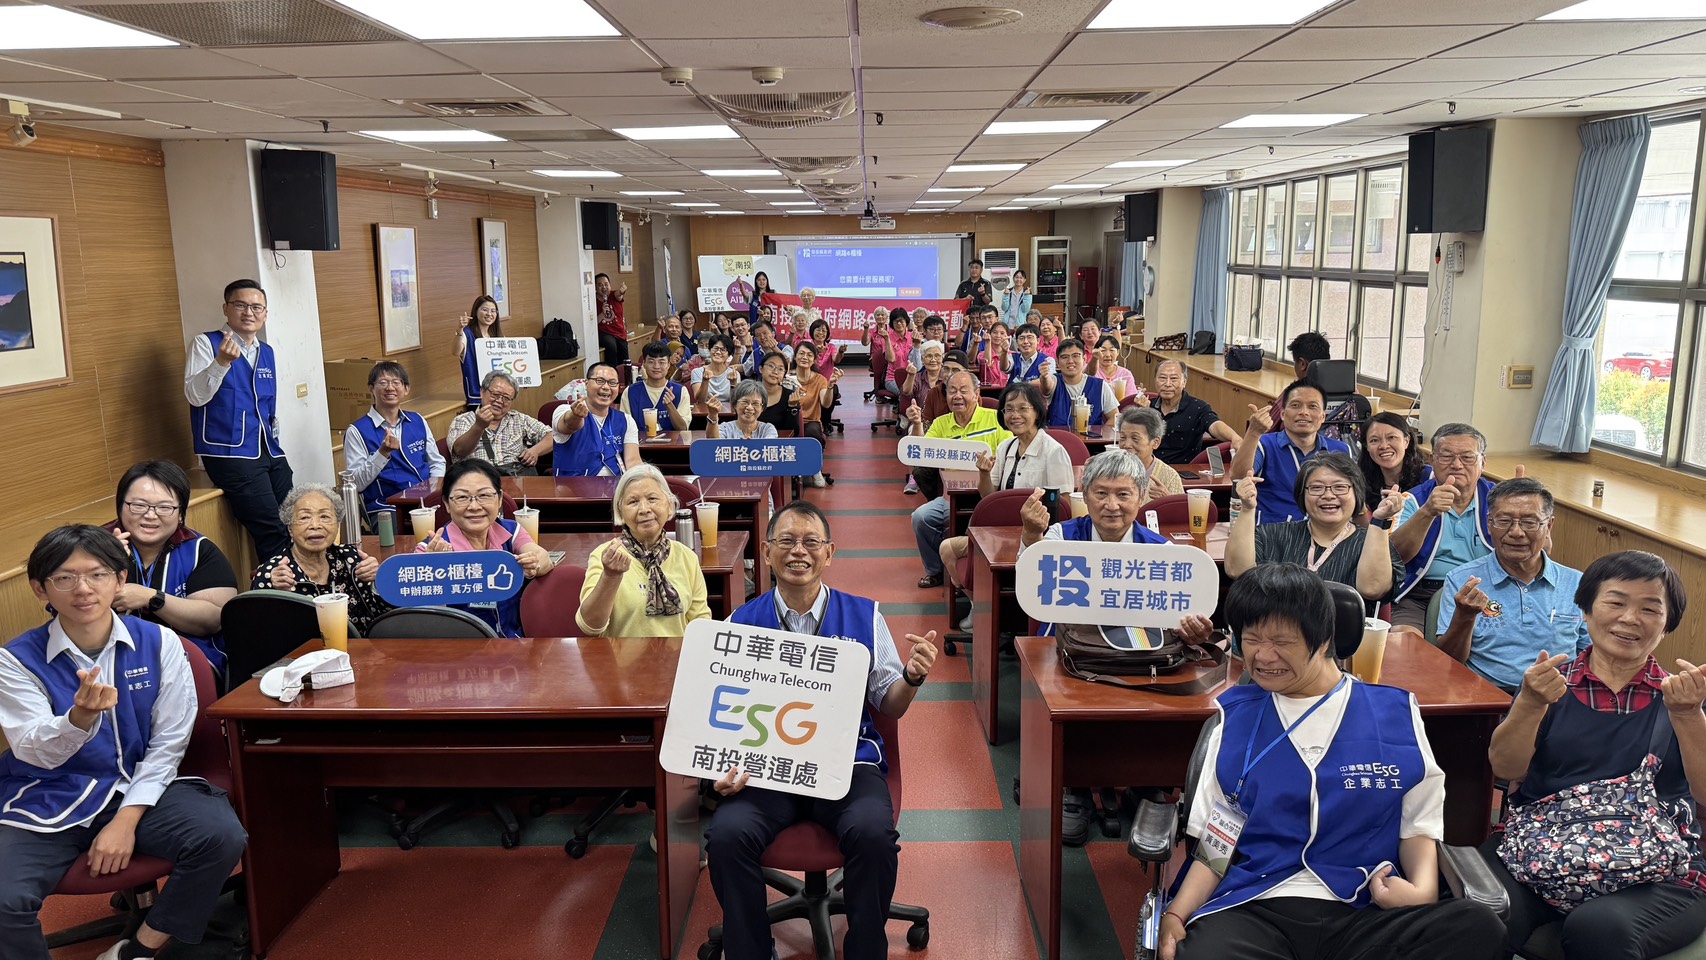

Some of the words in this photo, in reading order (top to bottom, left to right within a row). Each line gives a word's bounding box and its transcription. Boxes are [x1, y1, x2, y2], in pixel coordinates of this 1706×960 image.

[485, 340, 527, 349] 中華電信
[491, 358, 527, 375] ESG
[715, 445, 797, 463] 網路e櫃檯
[397, 563, 484, 583] 網路e櫃檯
[1100, 558, 1193, 582] 觀光首都
[400, 585, 443, 597] 申辦服務
[451, 583, 483, 595] 真方便
[1099, 588, 1192, 612] 宜居城市
[713, 630, 839, 674] 中華電信
[709, 661, 777, 683] Chunghwa
[779, 671, 832, 692] Telecom
[708, 685, 818, 748] ESG
[691, 744, 819, 789] 南投營運處
[1372, 762, 1400, 777] ESG
[1343, 778, 1403, 789] 企業志工
